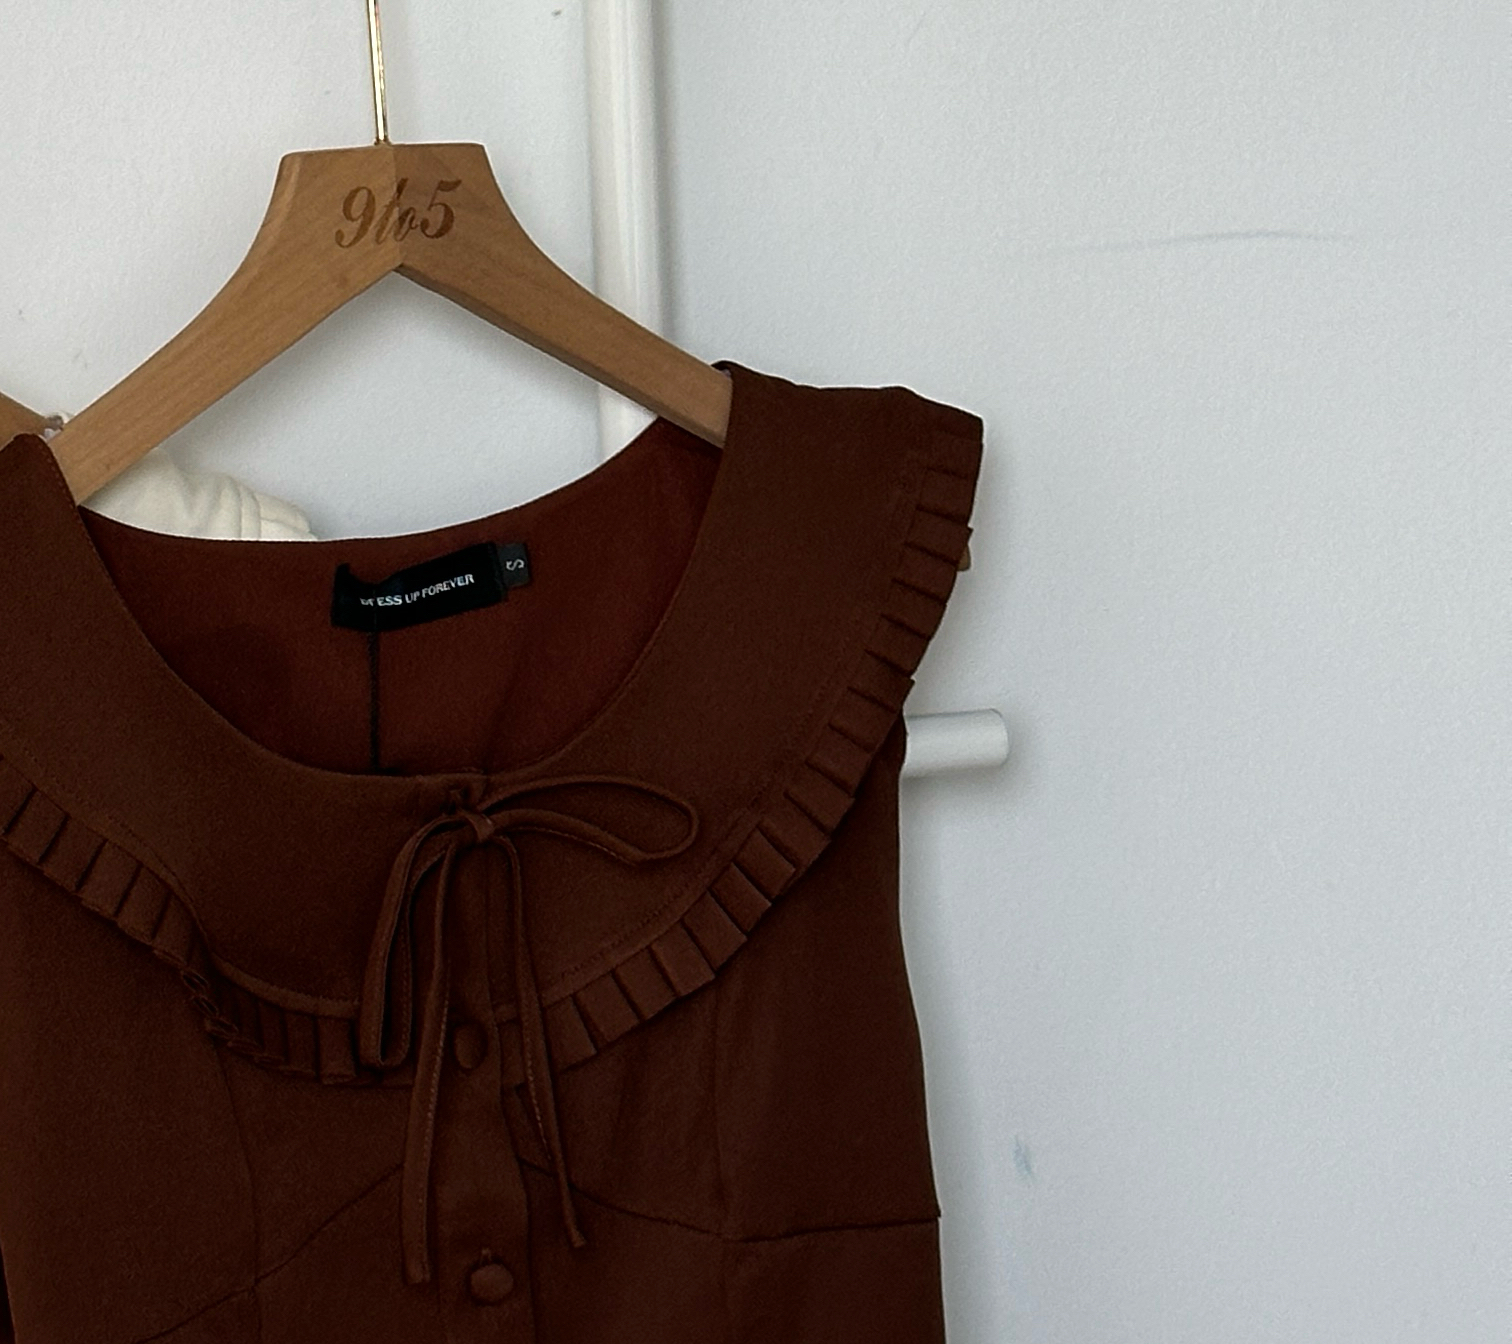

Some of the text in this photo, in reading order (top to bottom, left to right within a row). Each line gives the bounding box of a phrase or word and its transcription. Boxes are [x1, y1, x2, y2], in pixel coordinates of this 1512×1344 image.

[335, 177, 462, 248] 9to5
[505, 558, 525, 571] S
[405, 590, 421, 604] UP
[422, 573, 475, 598] FOREVER
